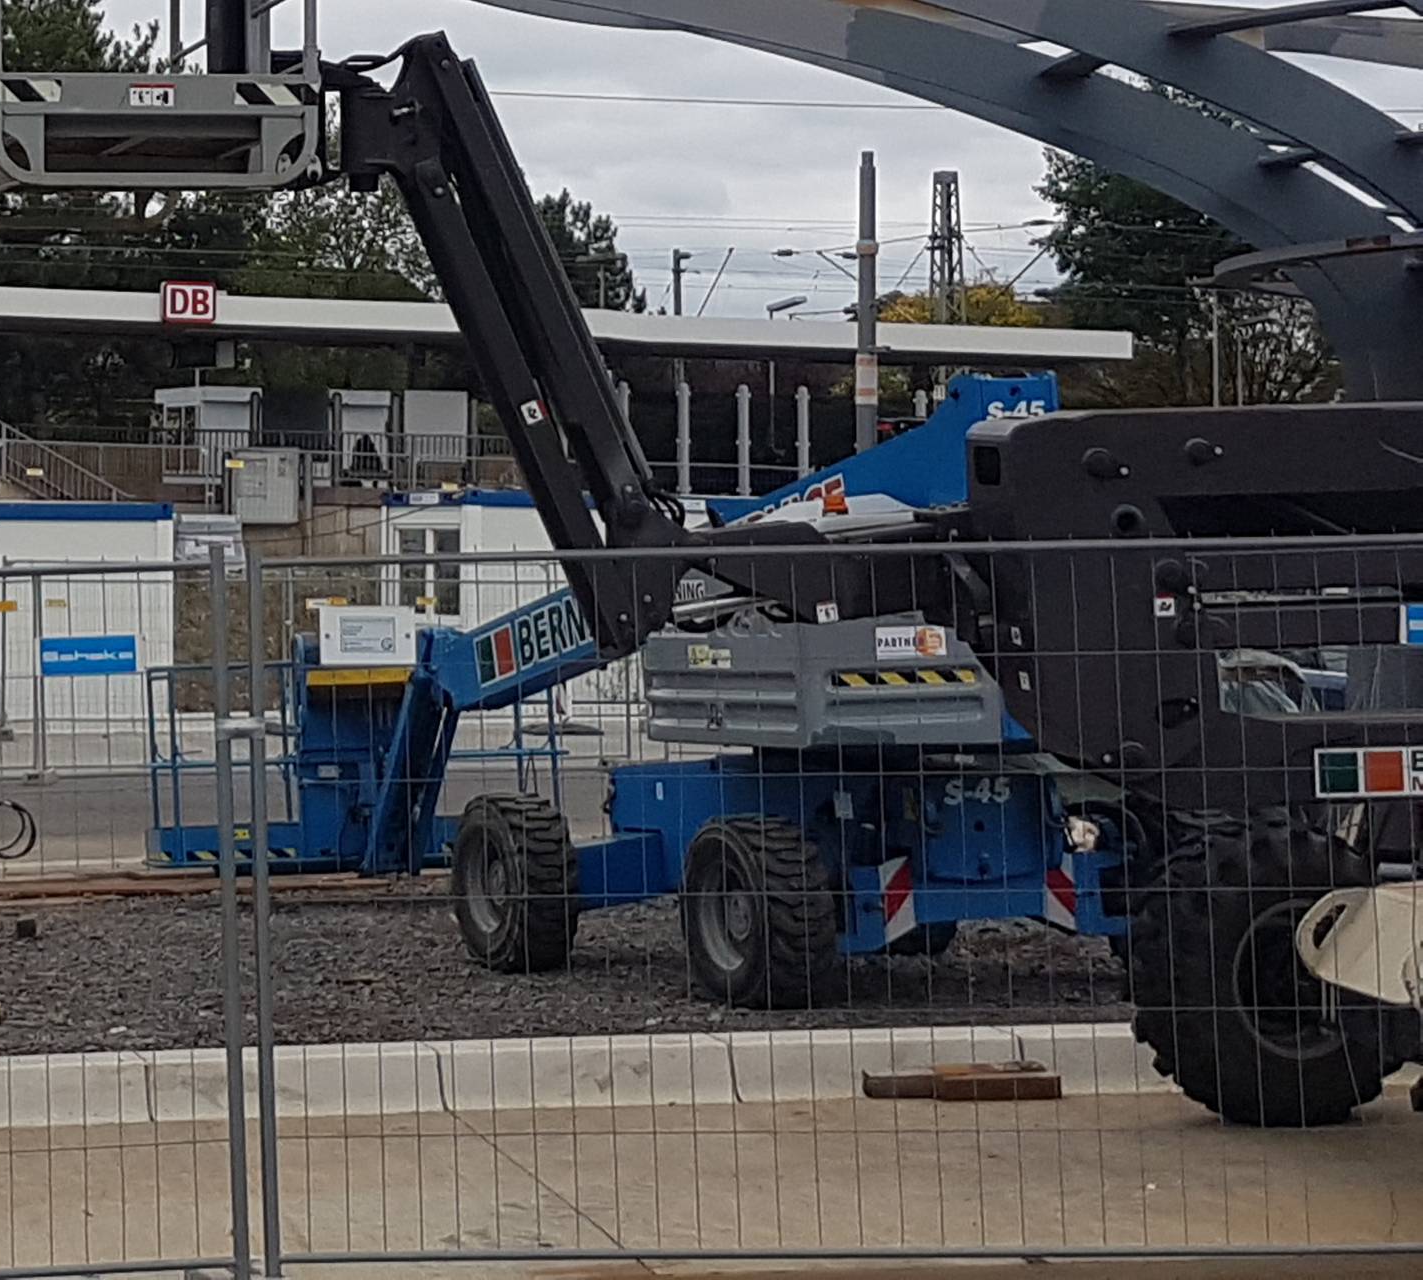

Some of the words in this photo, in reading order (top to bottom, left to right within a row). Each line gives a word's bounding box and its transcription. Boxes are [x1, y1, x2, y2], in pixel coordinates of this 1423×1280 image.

[170, 288, 210, 315] DB
[986, 400, 1046, 420] S-45
[516, 596, 589, 669] BERN
[944, 776, 1011, 805] S-45
